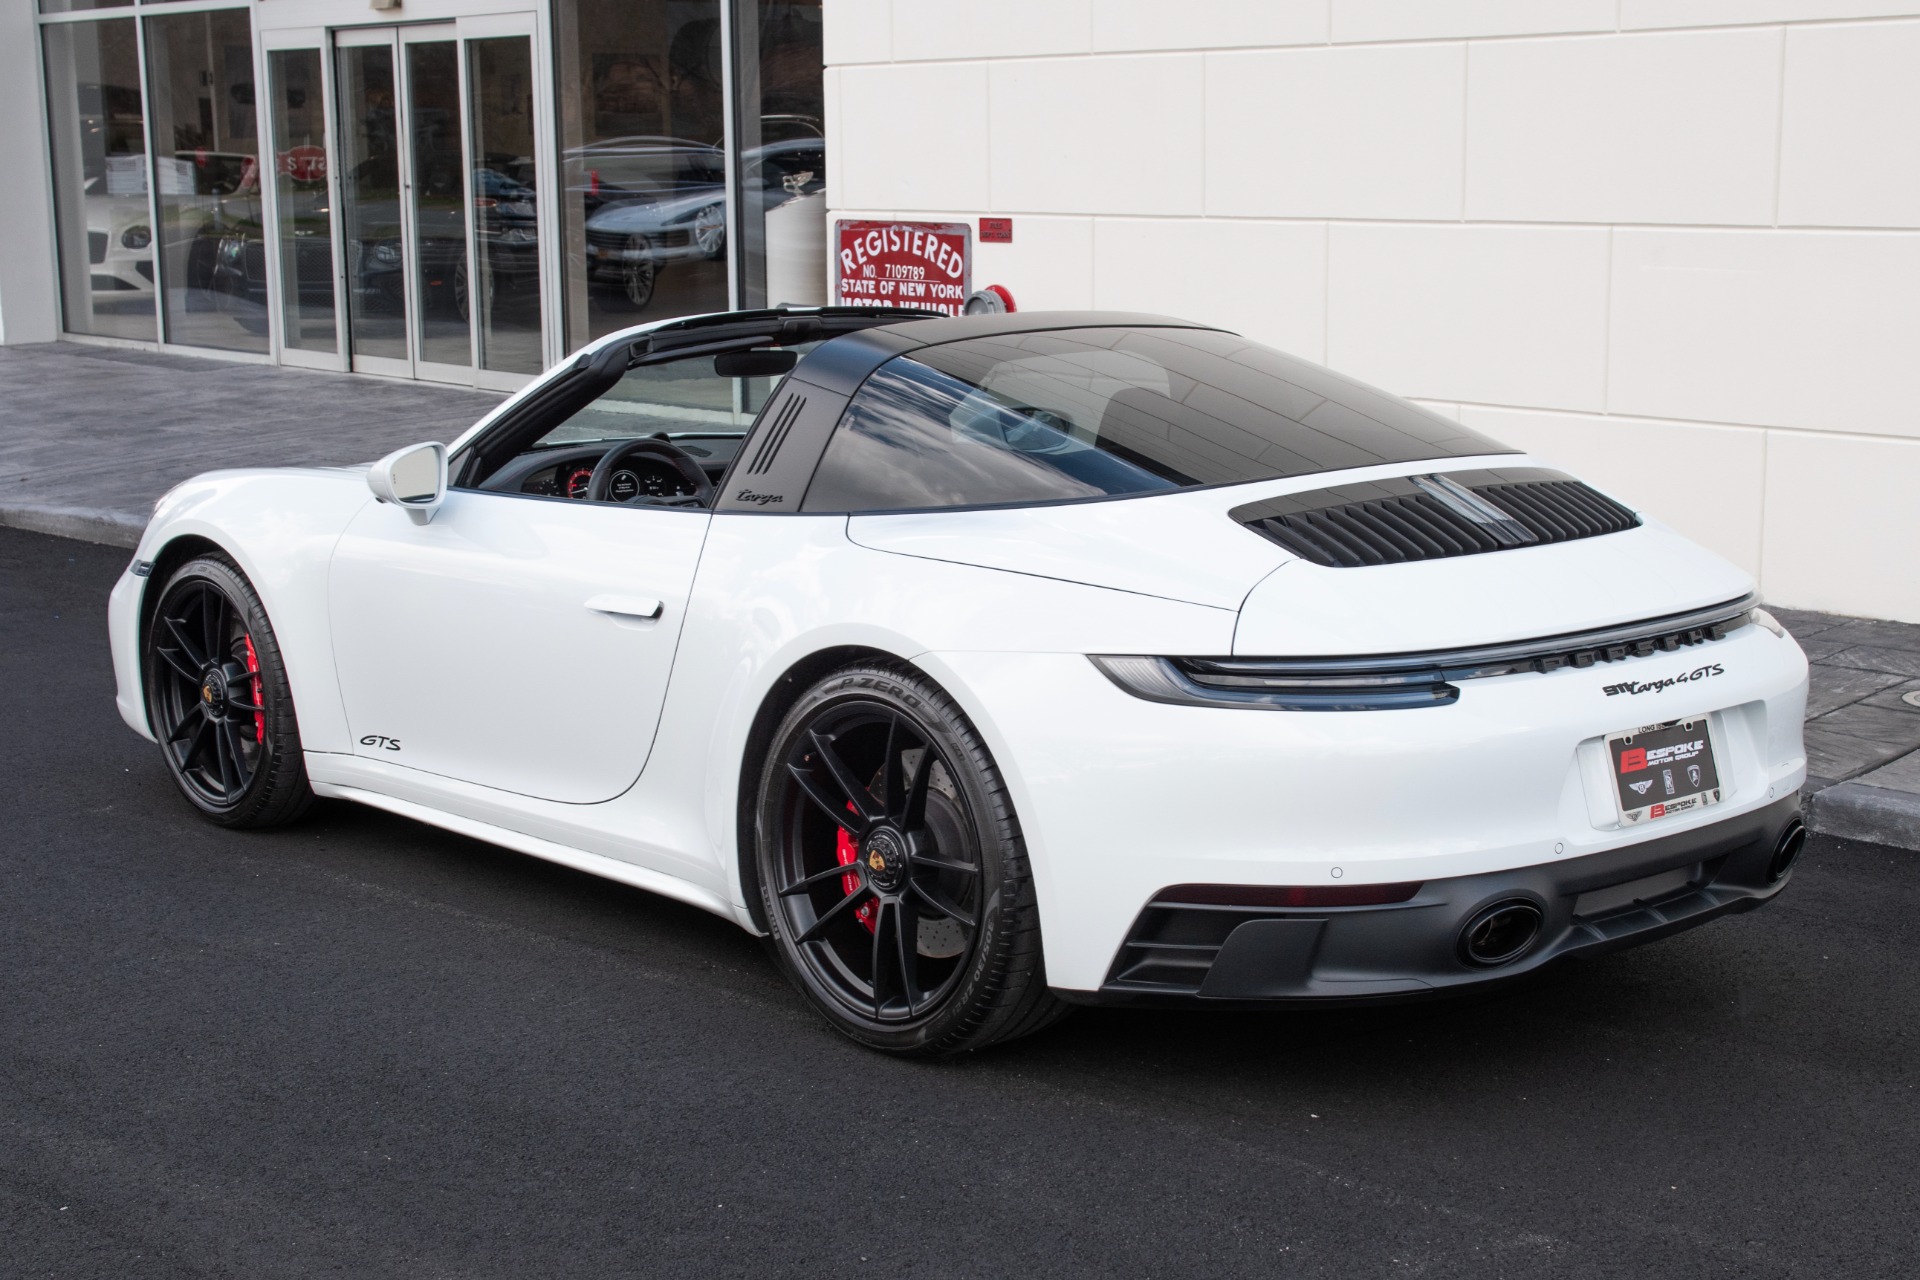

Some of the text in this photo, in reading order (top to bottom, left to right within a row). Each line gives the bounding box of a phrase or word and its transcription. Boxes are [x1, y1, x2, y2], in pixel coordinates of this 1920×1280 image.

[840, 225, 963, 279] REGISTERED
[863, 263, 925, 280] NO. 7109789
[841, 278, 964, 300] STATE OF NEW YORK
[735, 489, 783, 506] targa
[1630, 678, 1676, 695] targa
[1676, 672, 1689, 683] 4
[1689, 663, 1725, 681] GTS
[840, 677, 922, 710] P ZERO
[1637, 724, 1656, 735] LONG
[360, 735, 401, 751] GTS
[1621, 740, 1704, 774] BESPOKE
[1647, 750, 1699, 767] MOTOR GROUP
[1650, 797, 1697, 819] BESPOKE
[974, 918, 995, 982] 305/30
